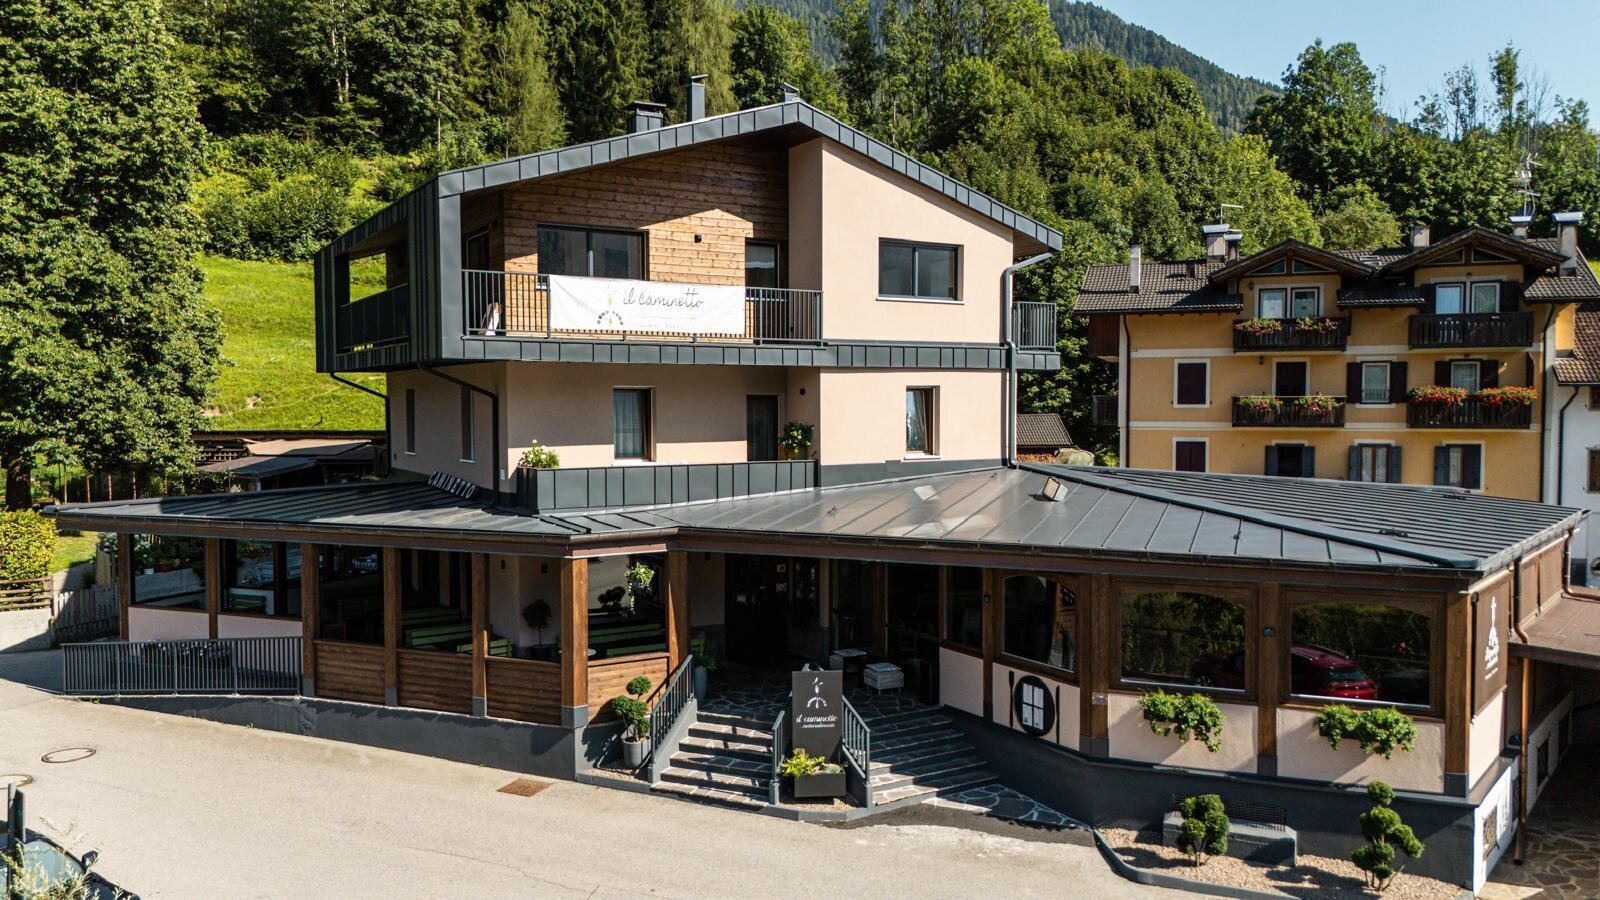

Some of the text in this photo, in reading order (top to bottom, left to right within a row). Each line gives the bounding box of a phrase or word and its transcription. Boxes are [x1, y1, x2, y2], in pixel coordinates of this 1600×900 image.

[623, 287, 704, 308] il caminetto
[428, 471, 475, 499] CAMINETTO
[796, 714, 803, 723] il
